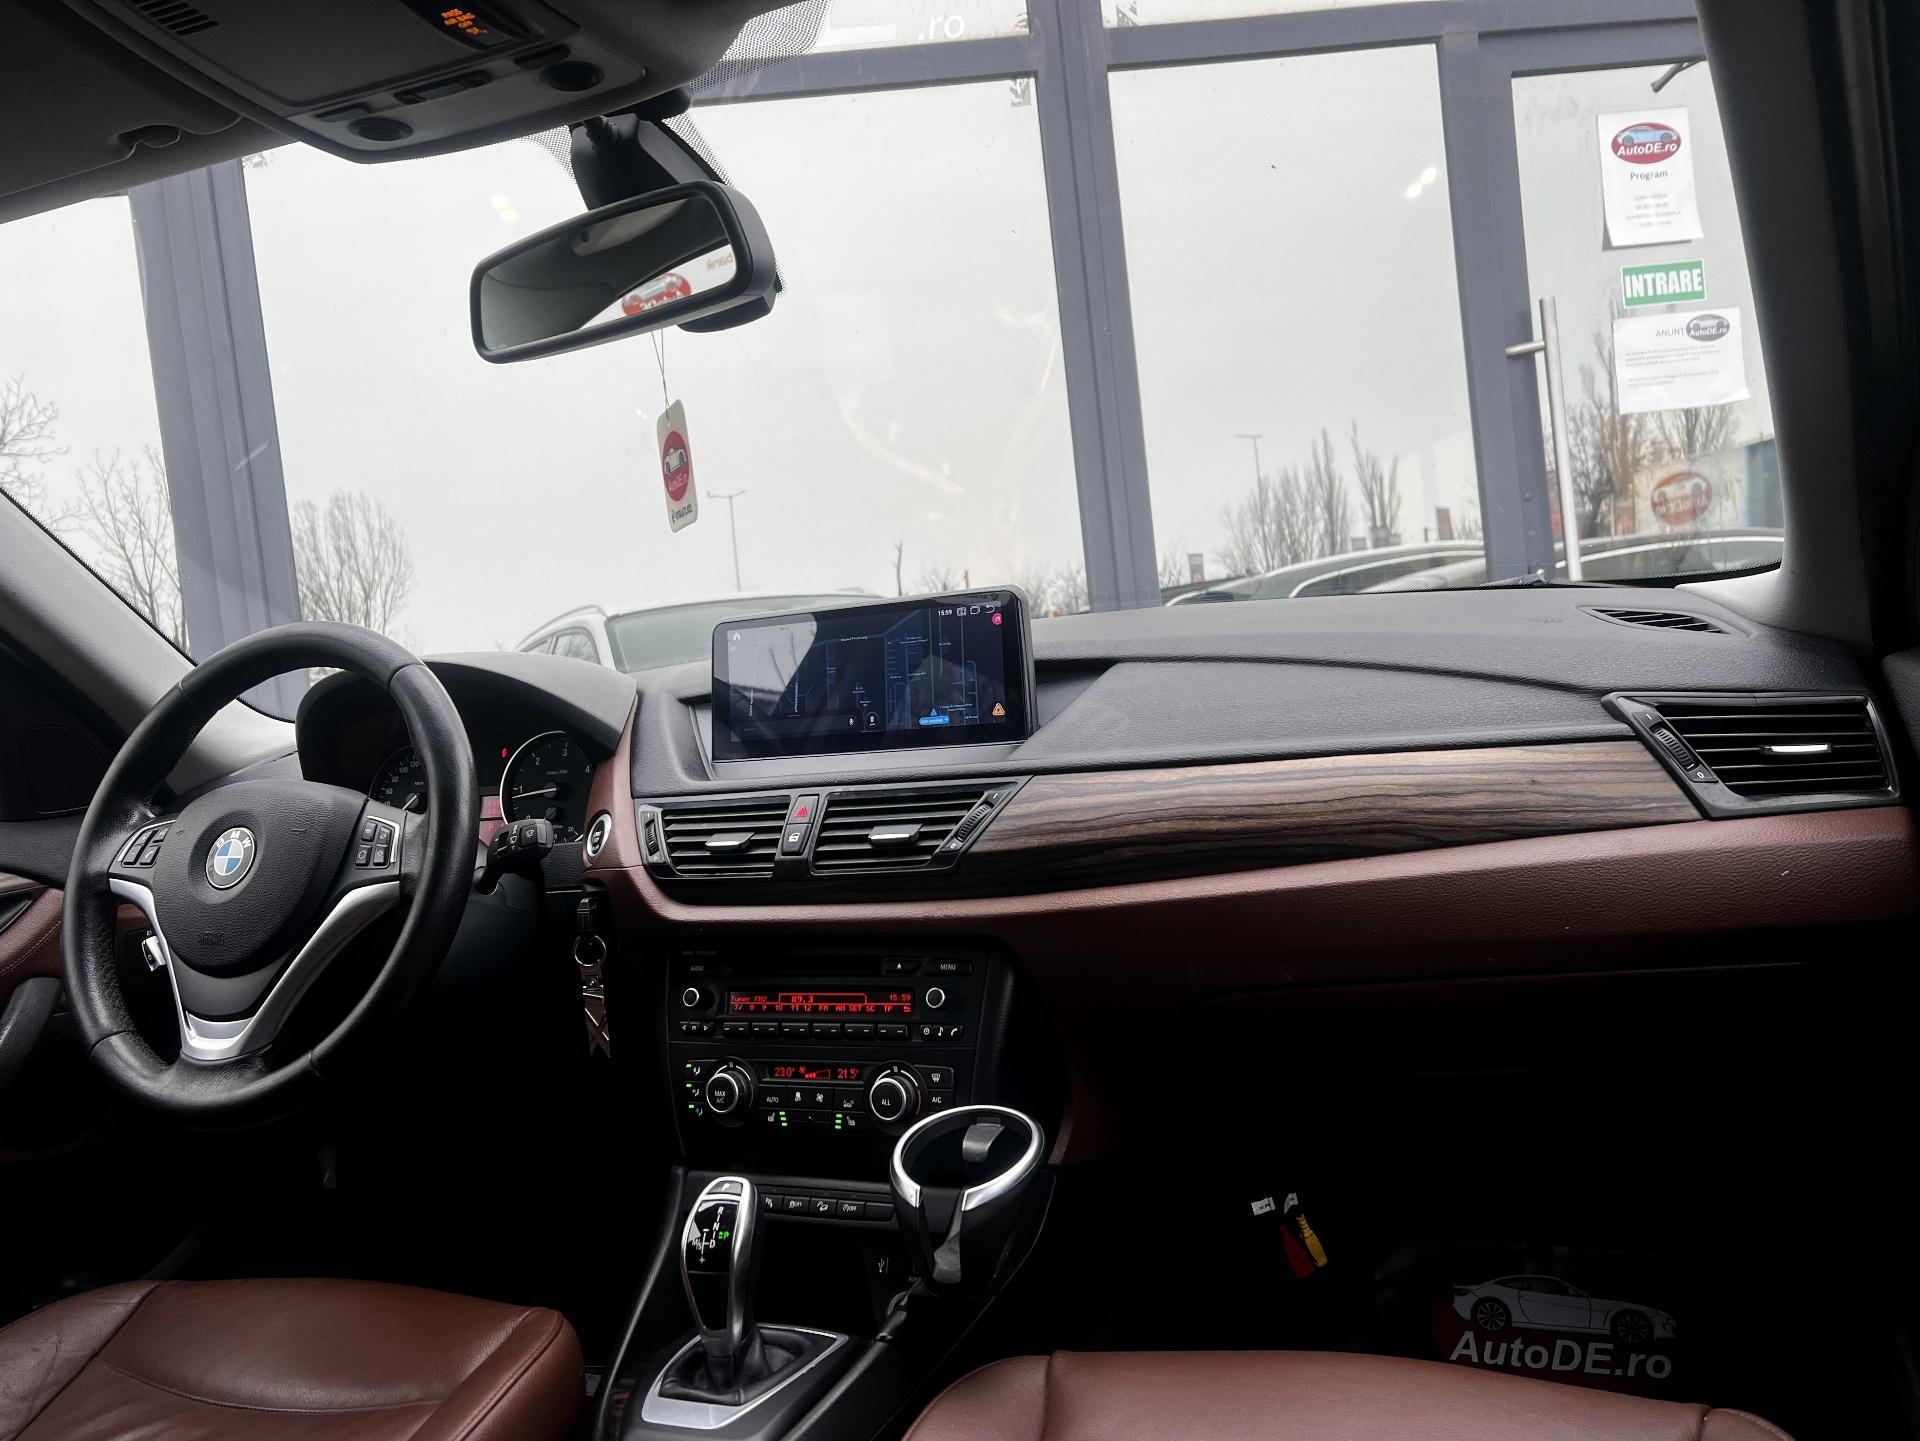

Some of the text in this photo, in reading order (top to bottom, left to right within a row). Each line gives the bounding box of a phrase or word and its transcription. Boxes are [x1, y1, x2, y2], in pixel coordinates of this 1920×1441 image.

[1616, 142, 1678, 157] AutoDE.ro
[1630, 170, 1668, 181] Program
[1624, 268, 1703, 299] INTRARE
[1689, 325, 1728, 338] AutoDE.ro
[938, 609, 953, 617] 15:59
[215, 830, 252, 849] BMW
[940, 962, 957, 971] MENU
[881, 1098, 891, 1106] ALL
[931, 1096, 942, 1104] A/C
[709, 1239, 716, 1249] D
[1449, 1330, 1672, 1379] AutoDE.ro
